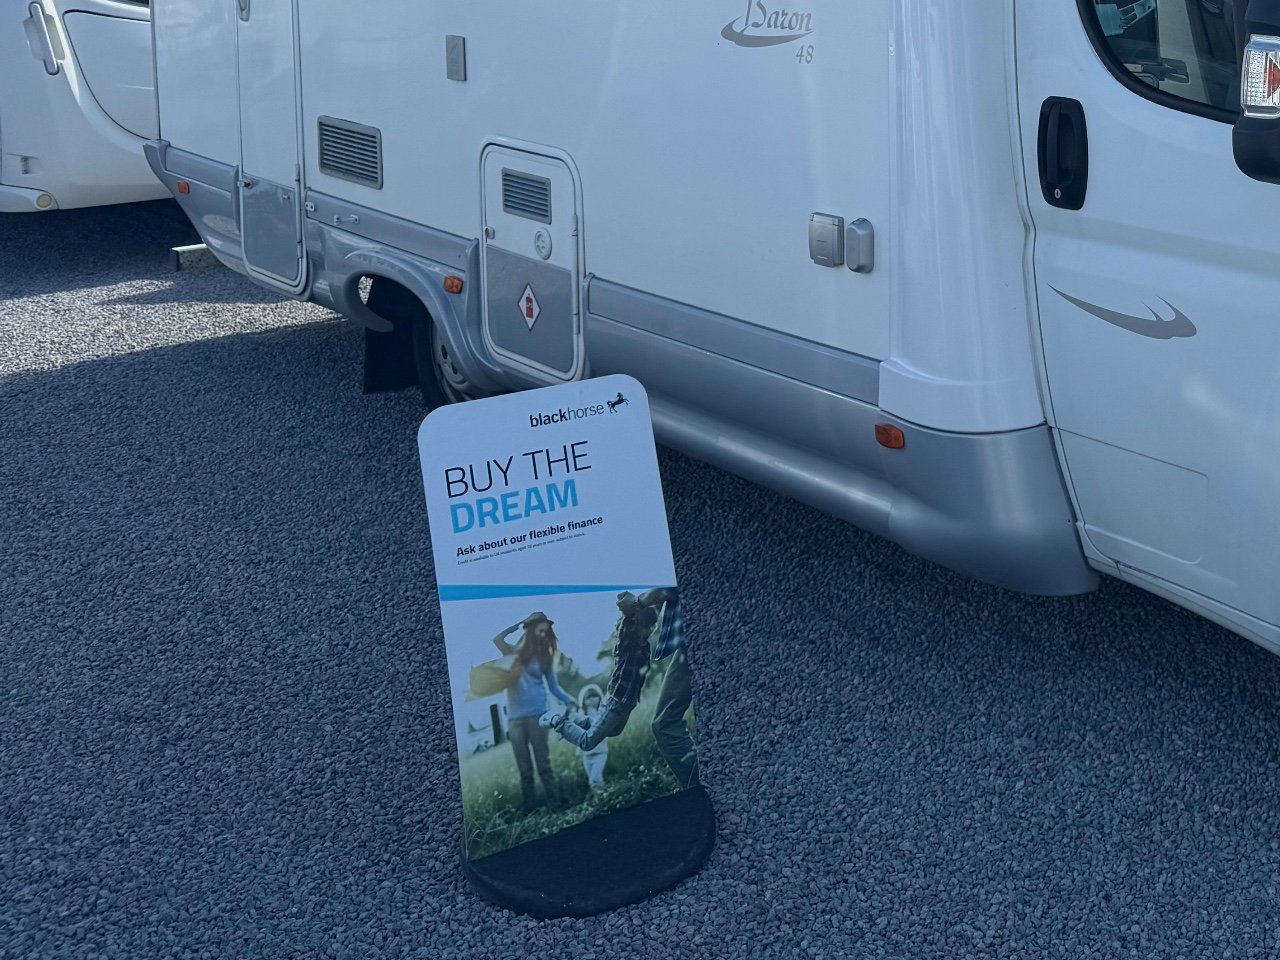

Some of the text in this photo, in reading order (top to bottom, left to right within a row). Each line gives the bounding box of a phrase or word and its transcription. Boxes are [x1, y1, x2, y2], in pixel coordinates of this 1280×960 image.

[795, 44, 814, 64] 48
[529, 402, 605, 428] blackhorse
[444, 441, 592, 498] BUY THE
[450, 479, 578, 533] DREAM
[457, 545, 476, 557] Ask
[479, 538, 508, 551] about
[510, 534, 527, 544] our
[529, 525, 565, 540] flexible
[568, 517, 603, 530] finance
